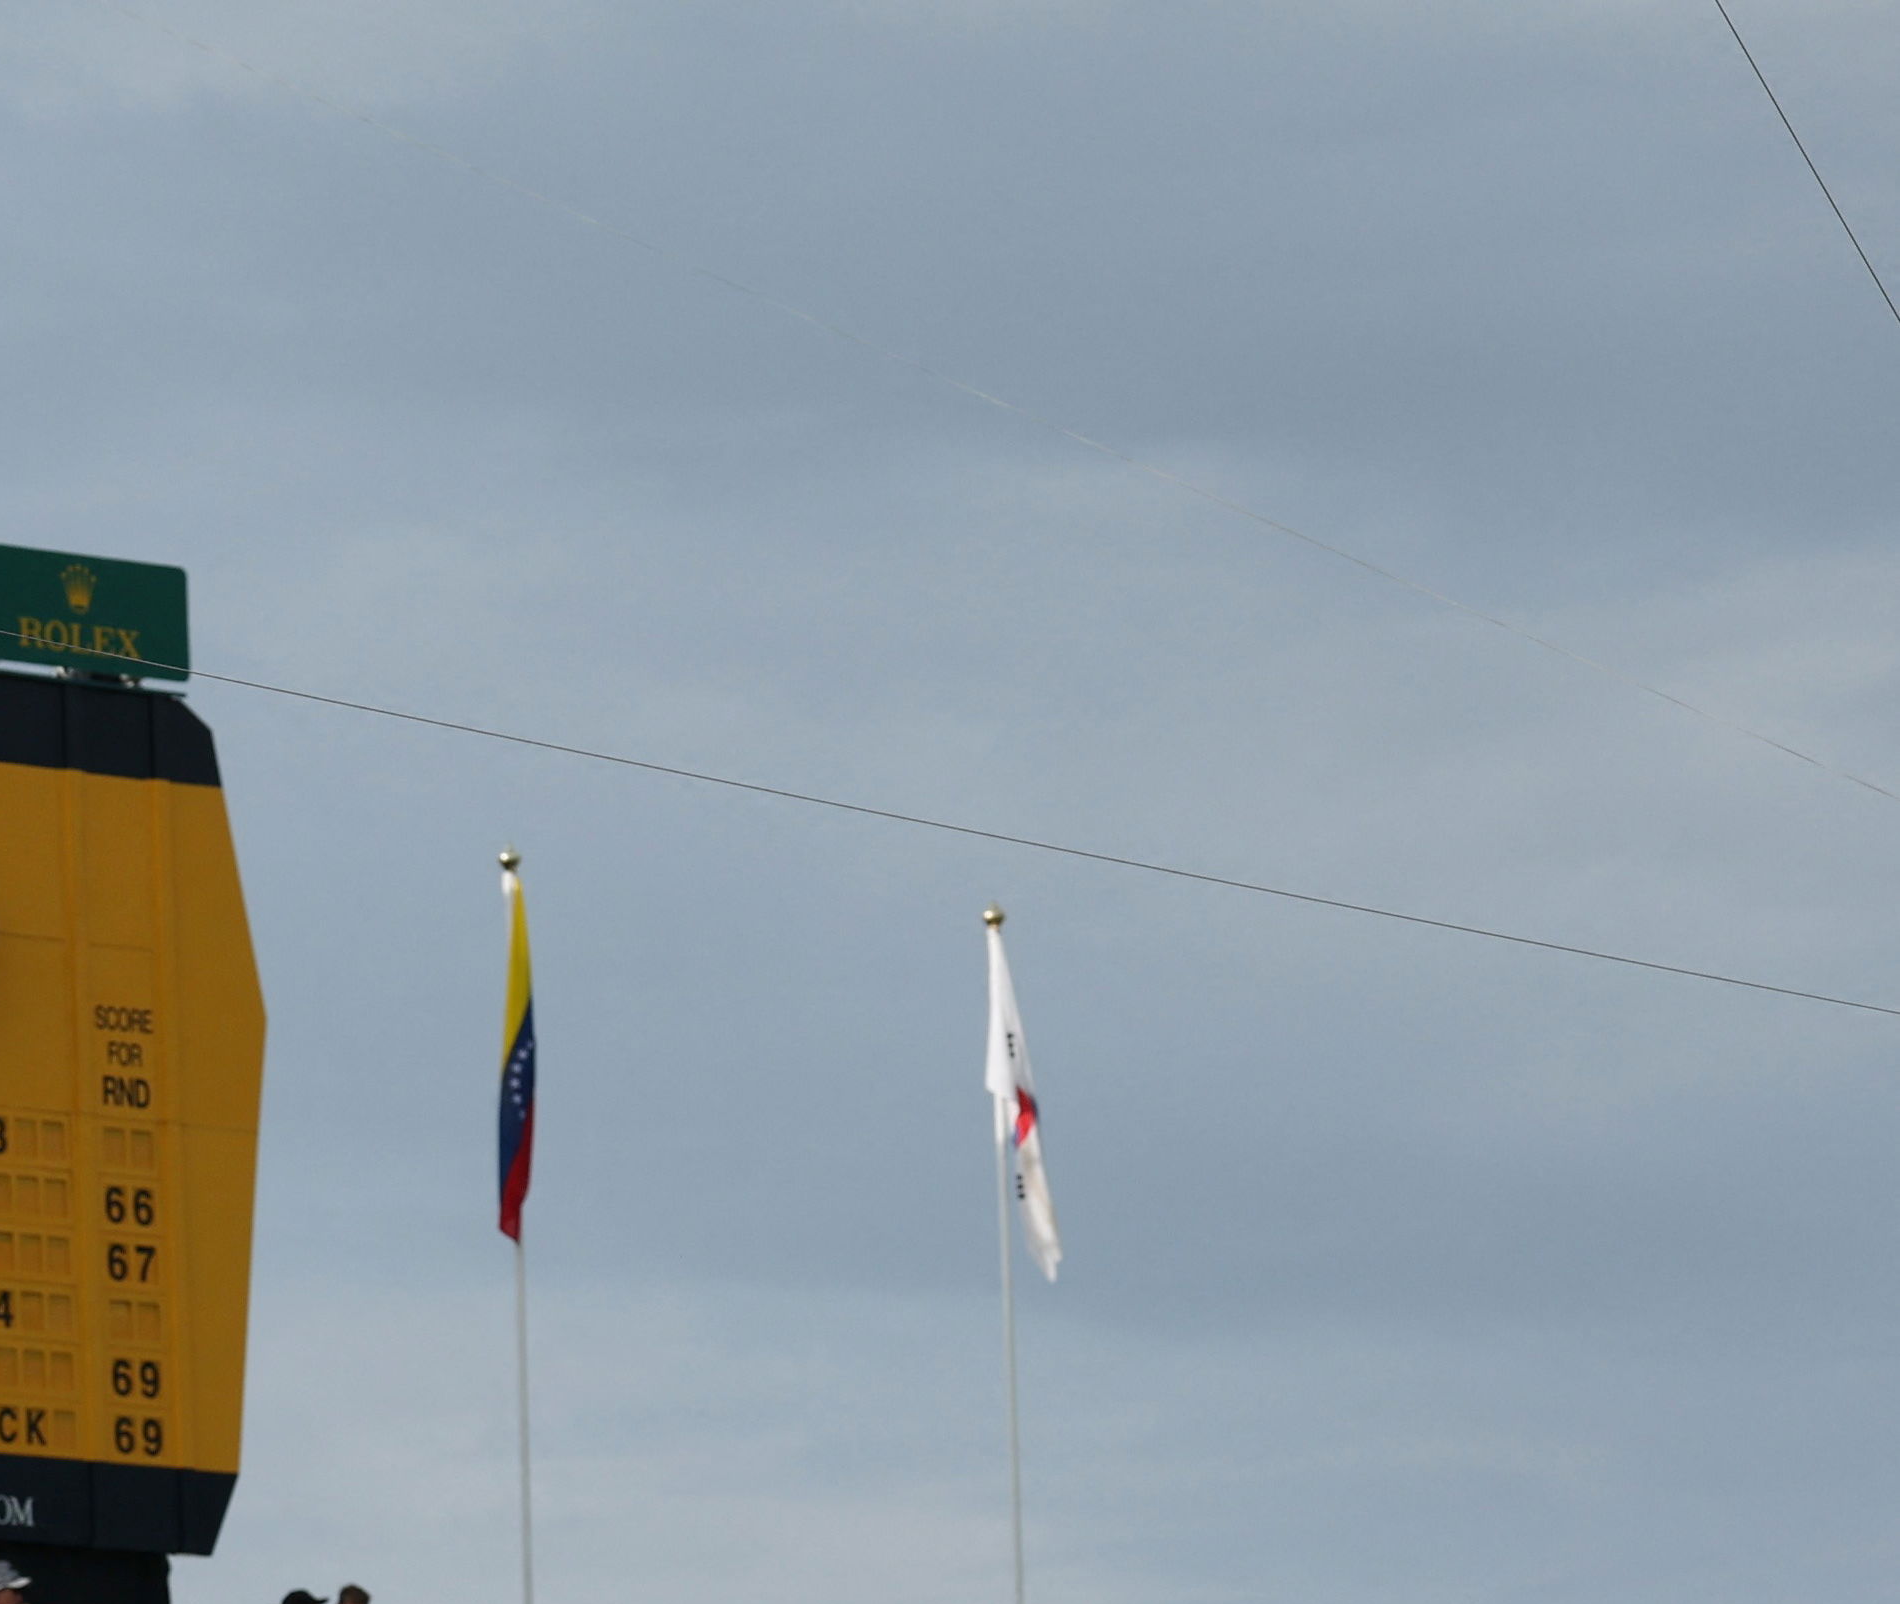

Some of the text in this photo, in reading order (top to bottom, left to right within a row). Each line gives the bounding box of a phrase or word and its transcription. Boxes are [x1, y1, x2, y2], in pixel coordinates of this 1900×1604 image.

[17, 616, 141, 661] ROLEX
[94, 1004, 154, 1035] SCORE
[107, 1039, 142, 1068] FOR
[102, 1074, 151, 1109] RND
[105, 1186, 155, 1227] 66
[107, 1243, 157, 1284] 67
[112, 1359, 161, 1399] 69
[114, 1416, 163, 1457] 69
